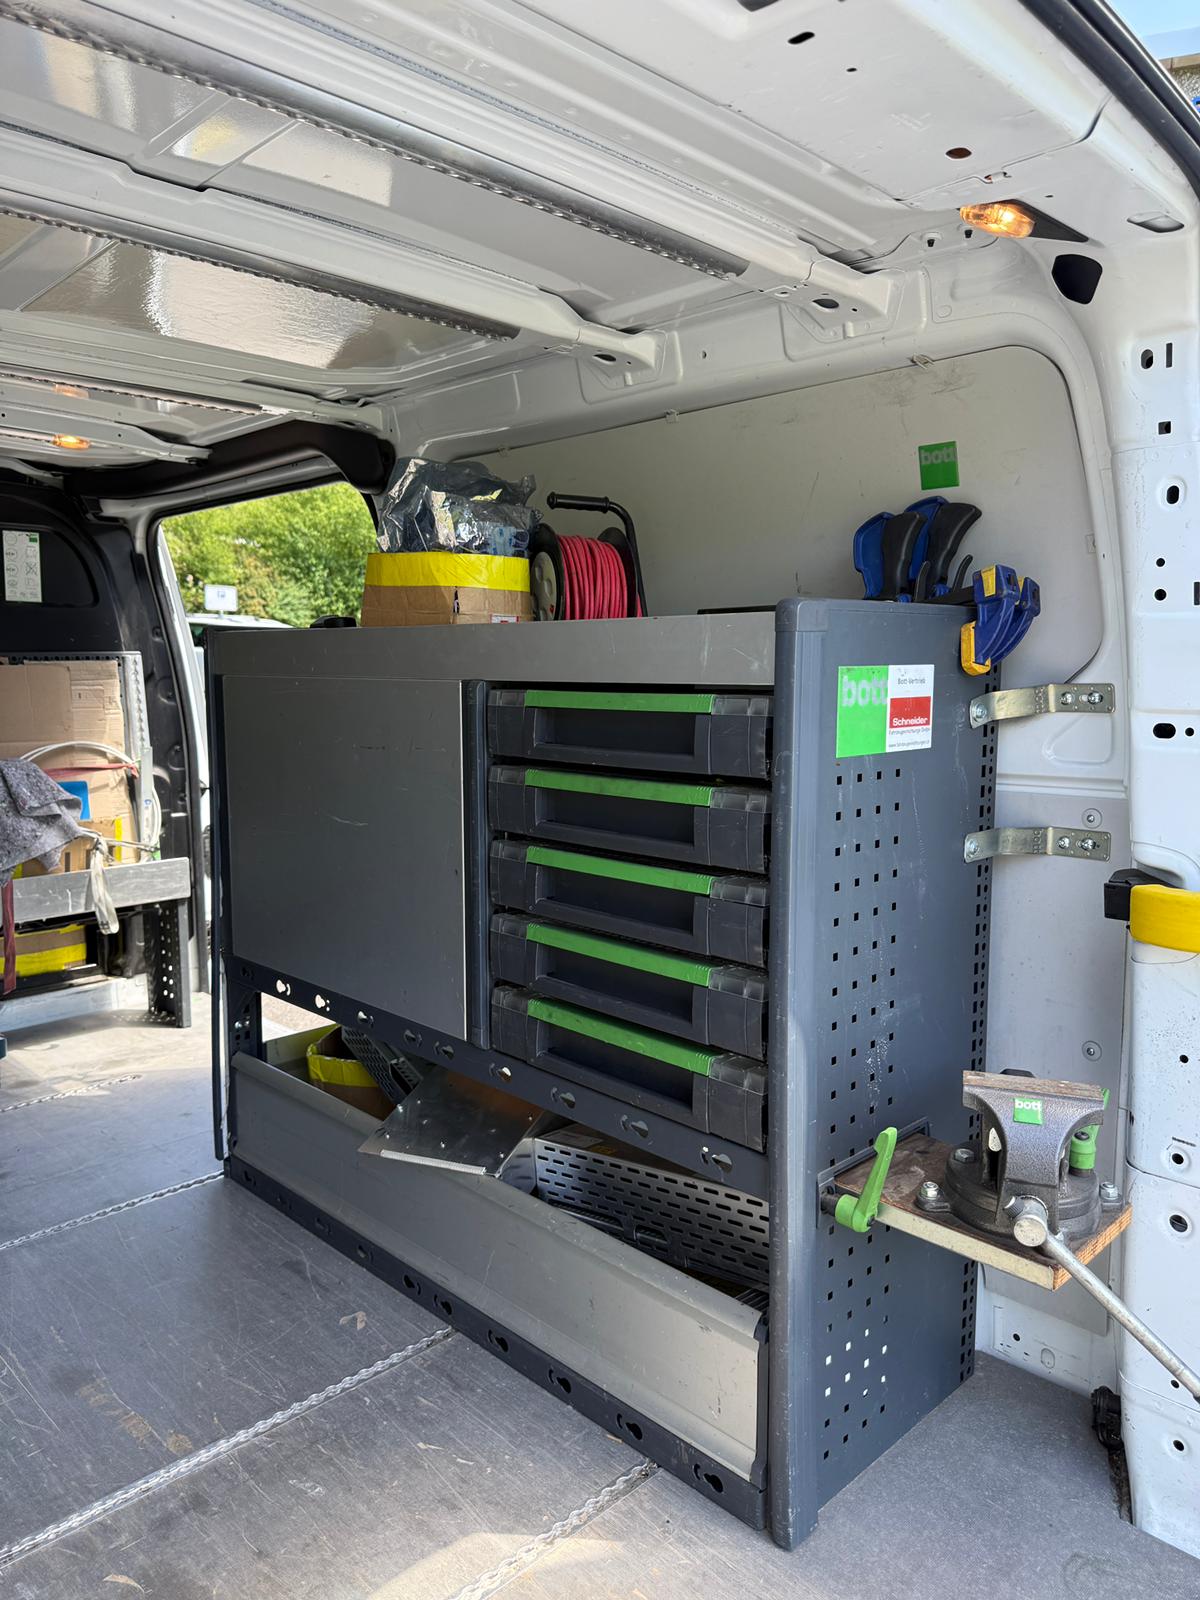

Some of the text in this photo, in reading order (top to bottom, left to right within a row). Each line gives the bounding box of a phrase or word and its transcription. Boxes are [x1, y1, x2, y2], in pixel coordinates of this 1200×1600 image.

[920, 448, 957, 465] bott
[842, 675, 888, 707] bott
[892, 717, 929, 726] Schneider
[1014, 1099, 1042, 1110] bott
